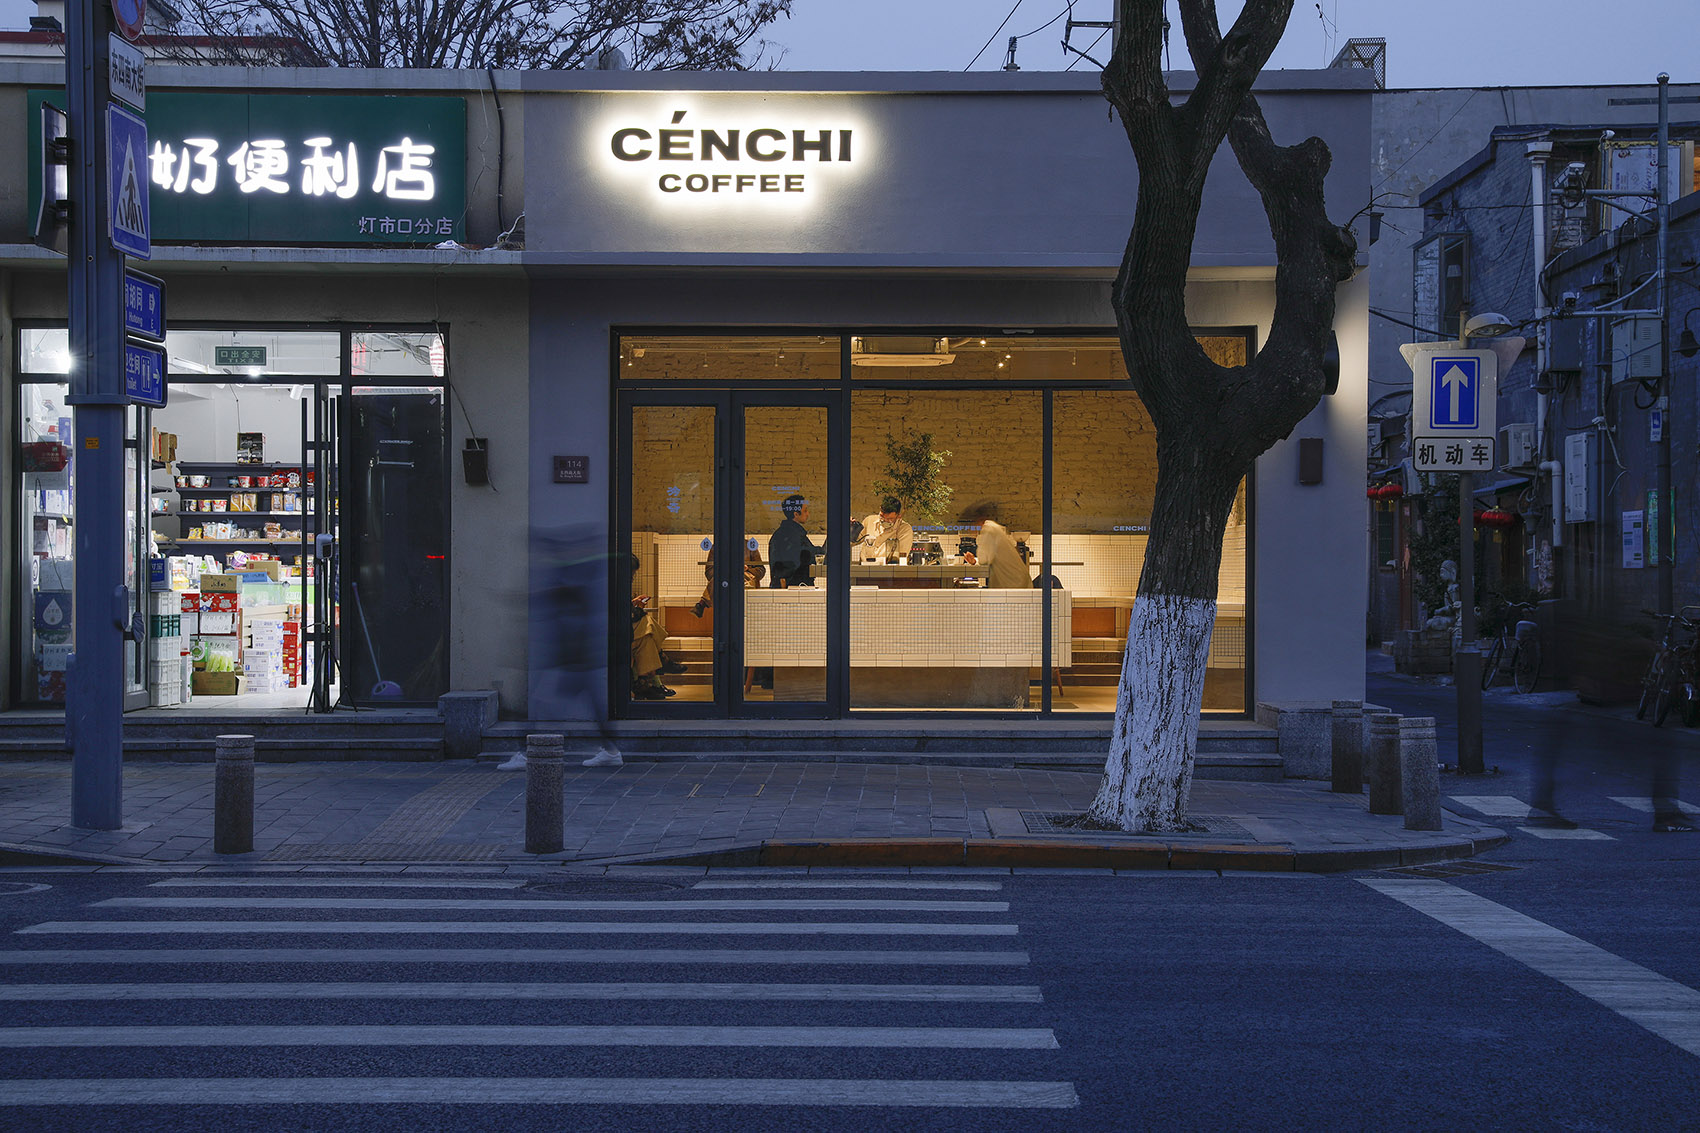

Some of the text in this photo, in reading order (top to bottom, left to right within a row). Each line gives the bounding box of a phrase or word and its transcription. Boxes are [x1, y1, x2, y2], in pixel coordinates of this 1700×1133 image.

[111, 48, 144, 97] 东四南大街
[610, 110, 853, 162] CÉNCHI
[658, 173, 805, 193] COFFEE
[358, 216, 453, 235] 灯市口分店
[567, 460, 582, 468] 114
[1418, 444, 1489, 465] 机动车
